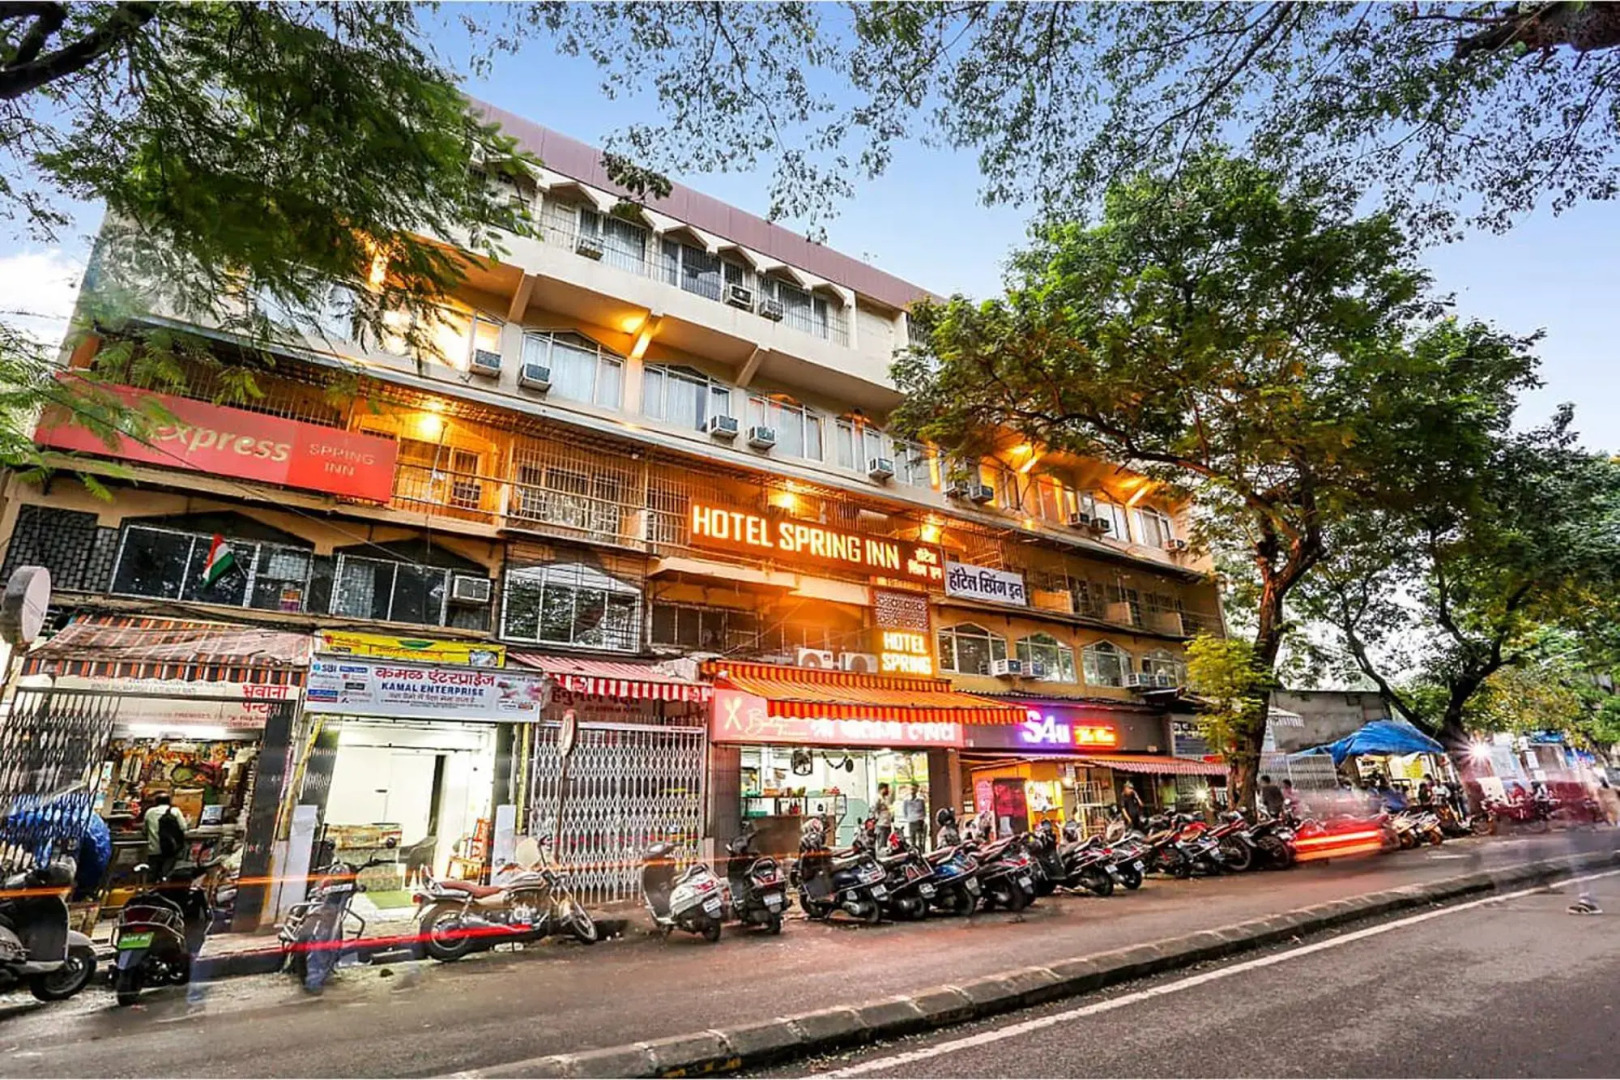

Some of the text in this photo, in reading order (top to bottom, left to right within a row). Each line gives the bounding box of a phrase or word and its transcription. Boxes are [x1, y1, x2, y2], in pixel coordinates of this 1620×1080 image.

[309, 443, 375, 465] SPRING
[324, 462, 354, 476] INN
[693, 506, 900, 570] HOTEL SPRING INN
[949, 567, 1024, 600] हॉटेल स्प्रिंग इन
[883, 631, 927, 654] HOTEL
[881, 652, 932, 675] SPRING
[382, 682, 417, 693] KAMAL
[420, 684, 485, 697] ENTERPRISE
